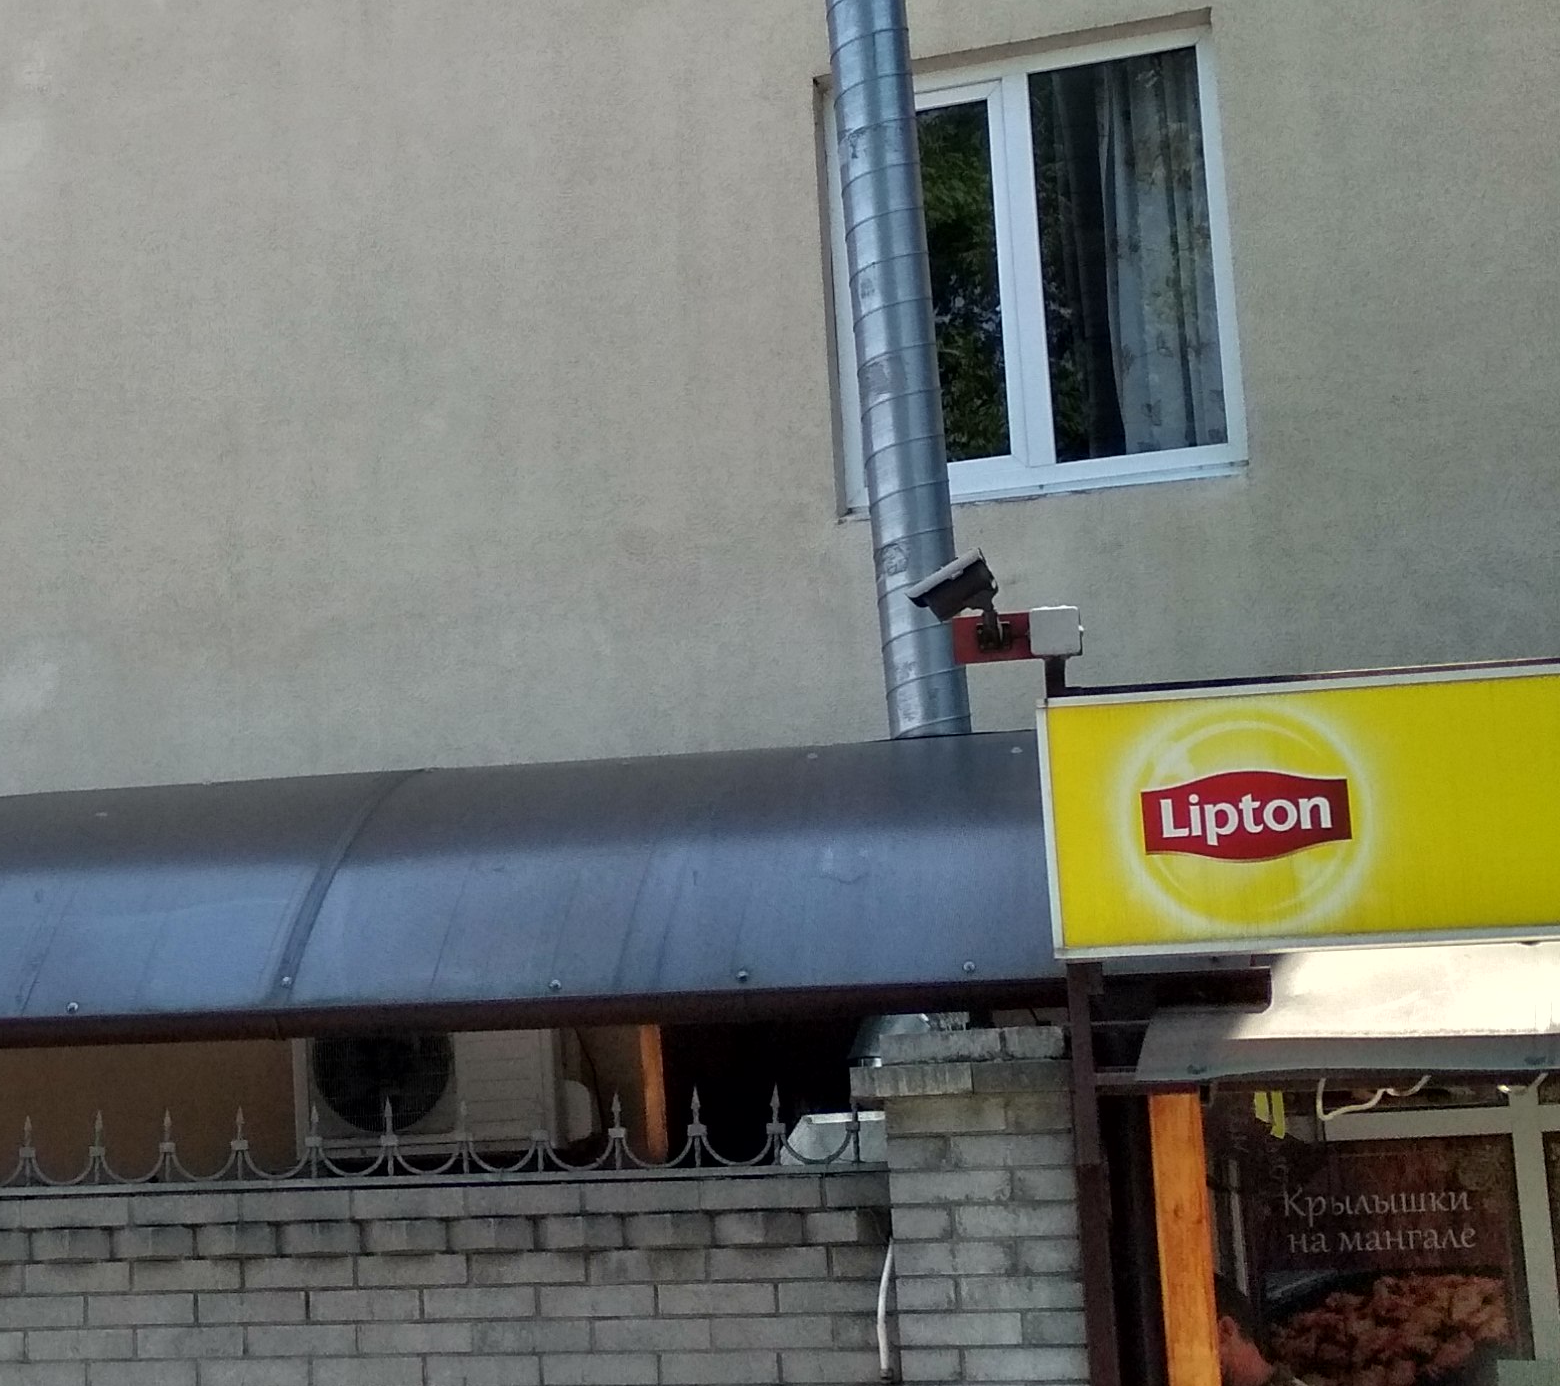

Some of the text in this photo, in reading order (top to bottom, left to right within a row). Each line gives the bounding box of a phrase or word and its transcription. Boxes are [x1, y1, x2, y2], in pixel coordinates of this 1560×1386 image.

[1159, 794, 1333, 847] Lipton
[1282, 1186, 1471, 1227] Крылышки
[1287, 1227, 1477, 1254] на мангале
